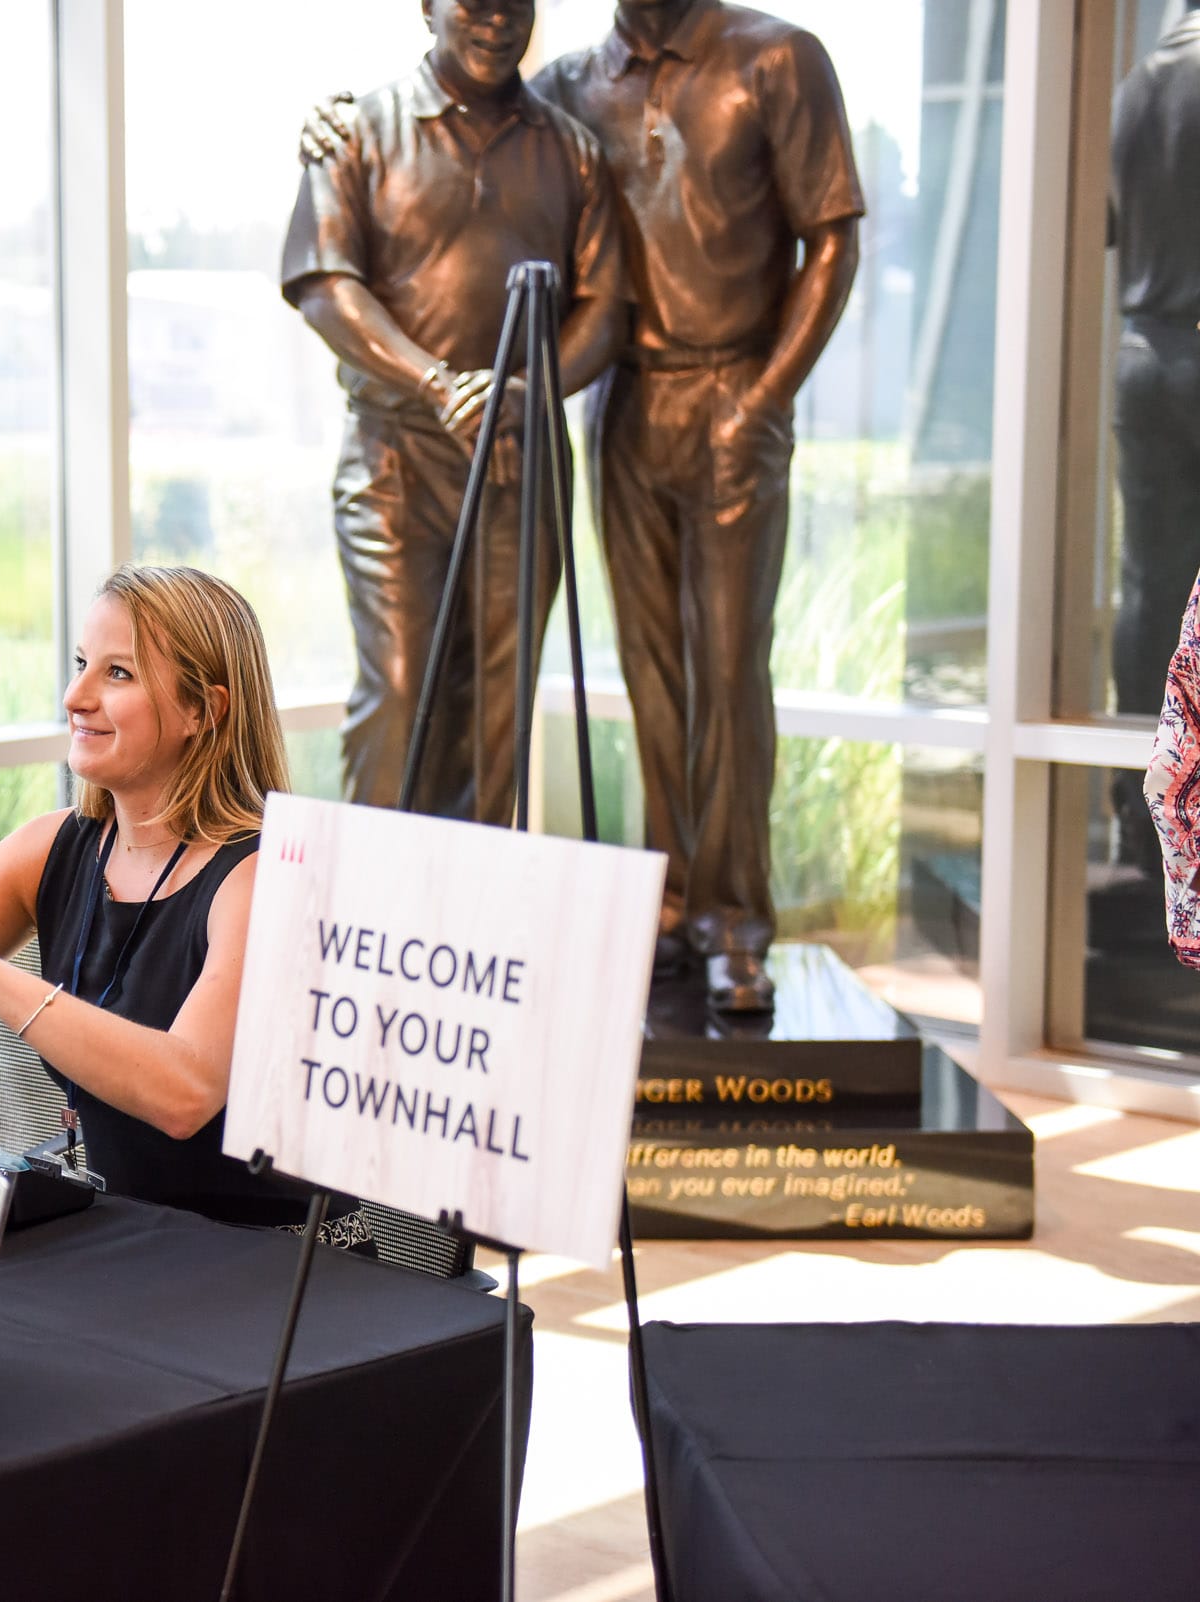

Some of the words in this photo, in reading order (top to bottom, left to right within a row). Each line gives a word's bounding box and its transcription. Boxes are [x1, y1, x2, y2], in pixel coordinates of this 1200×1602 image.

[318, 919, 526, 1004] WELCOME
[309, 988, 358, 1039] TO
[376, 1004, 491, 1073] YOUR
[300, 1058, 530, 1162] TOWNHALL
[745, 1144, 771, 1168] in
[776, 1144, 818, 1168] the
[668, 1177, 715, 1201] you
[720, 1177, 776, 1197] ever
[902, 1203, 986, 1228] Woods
